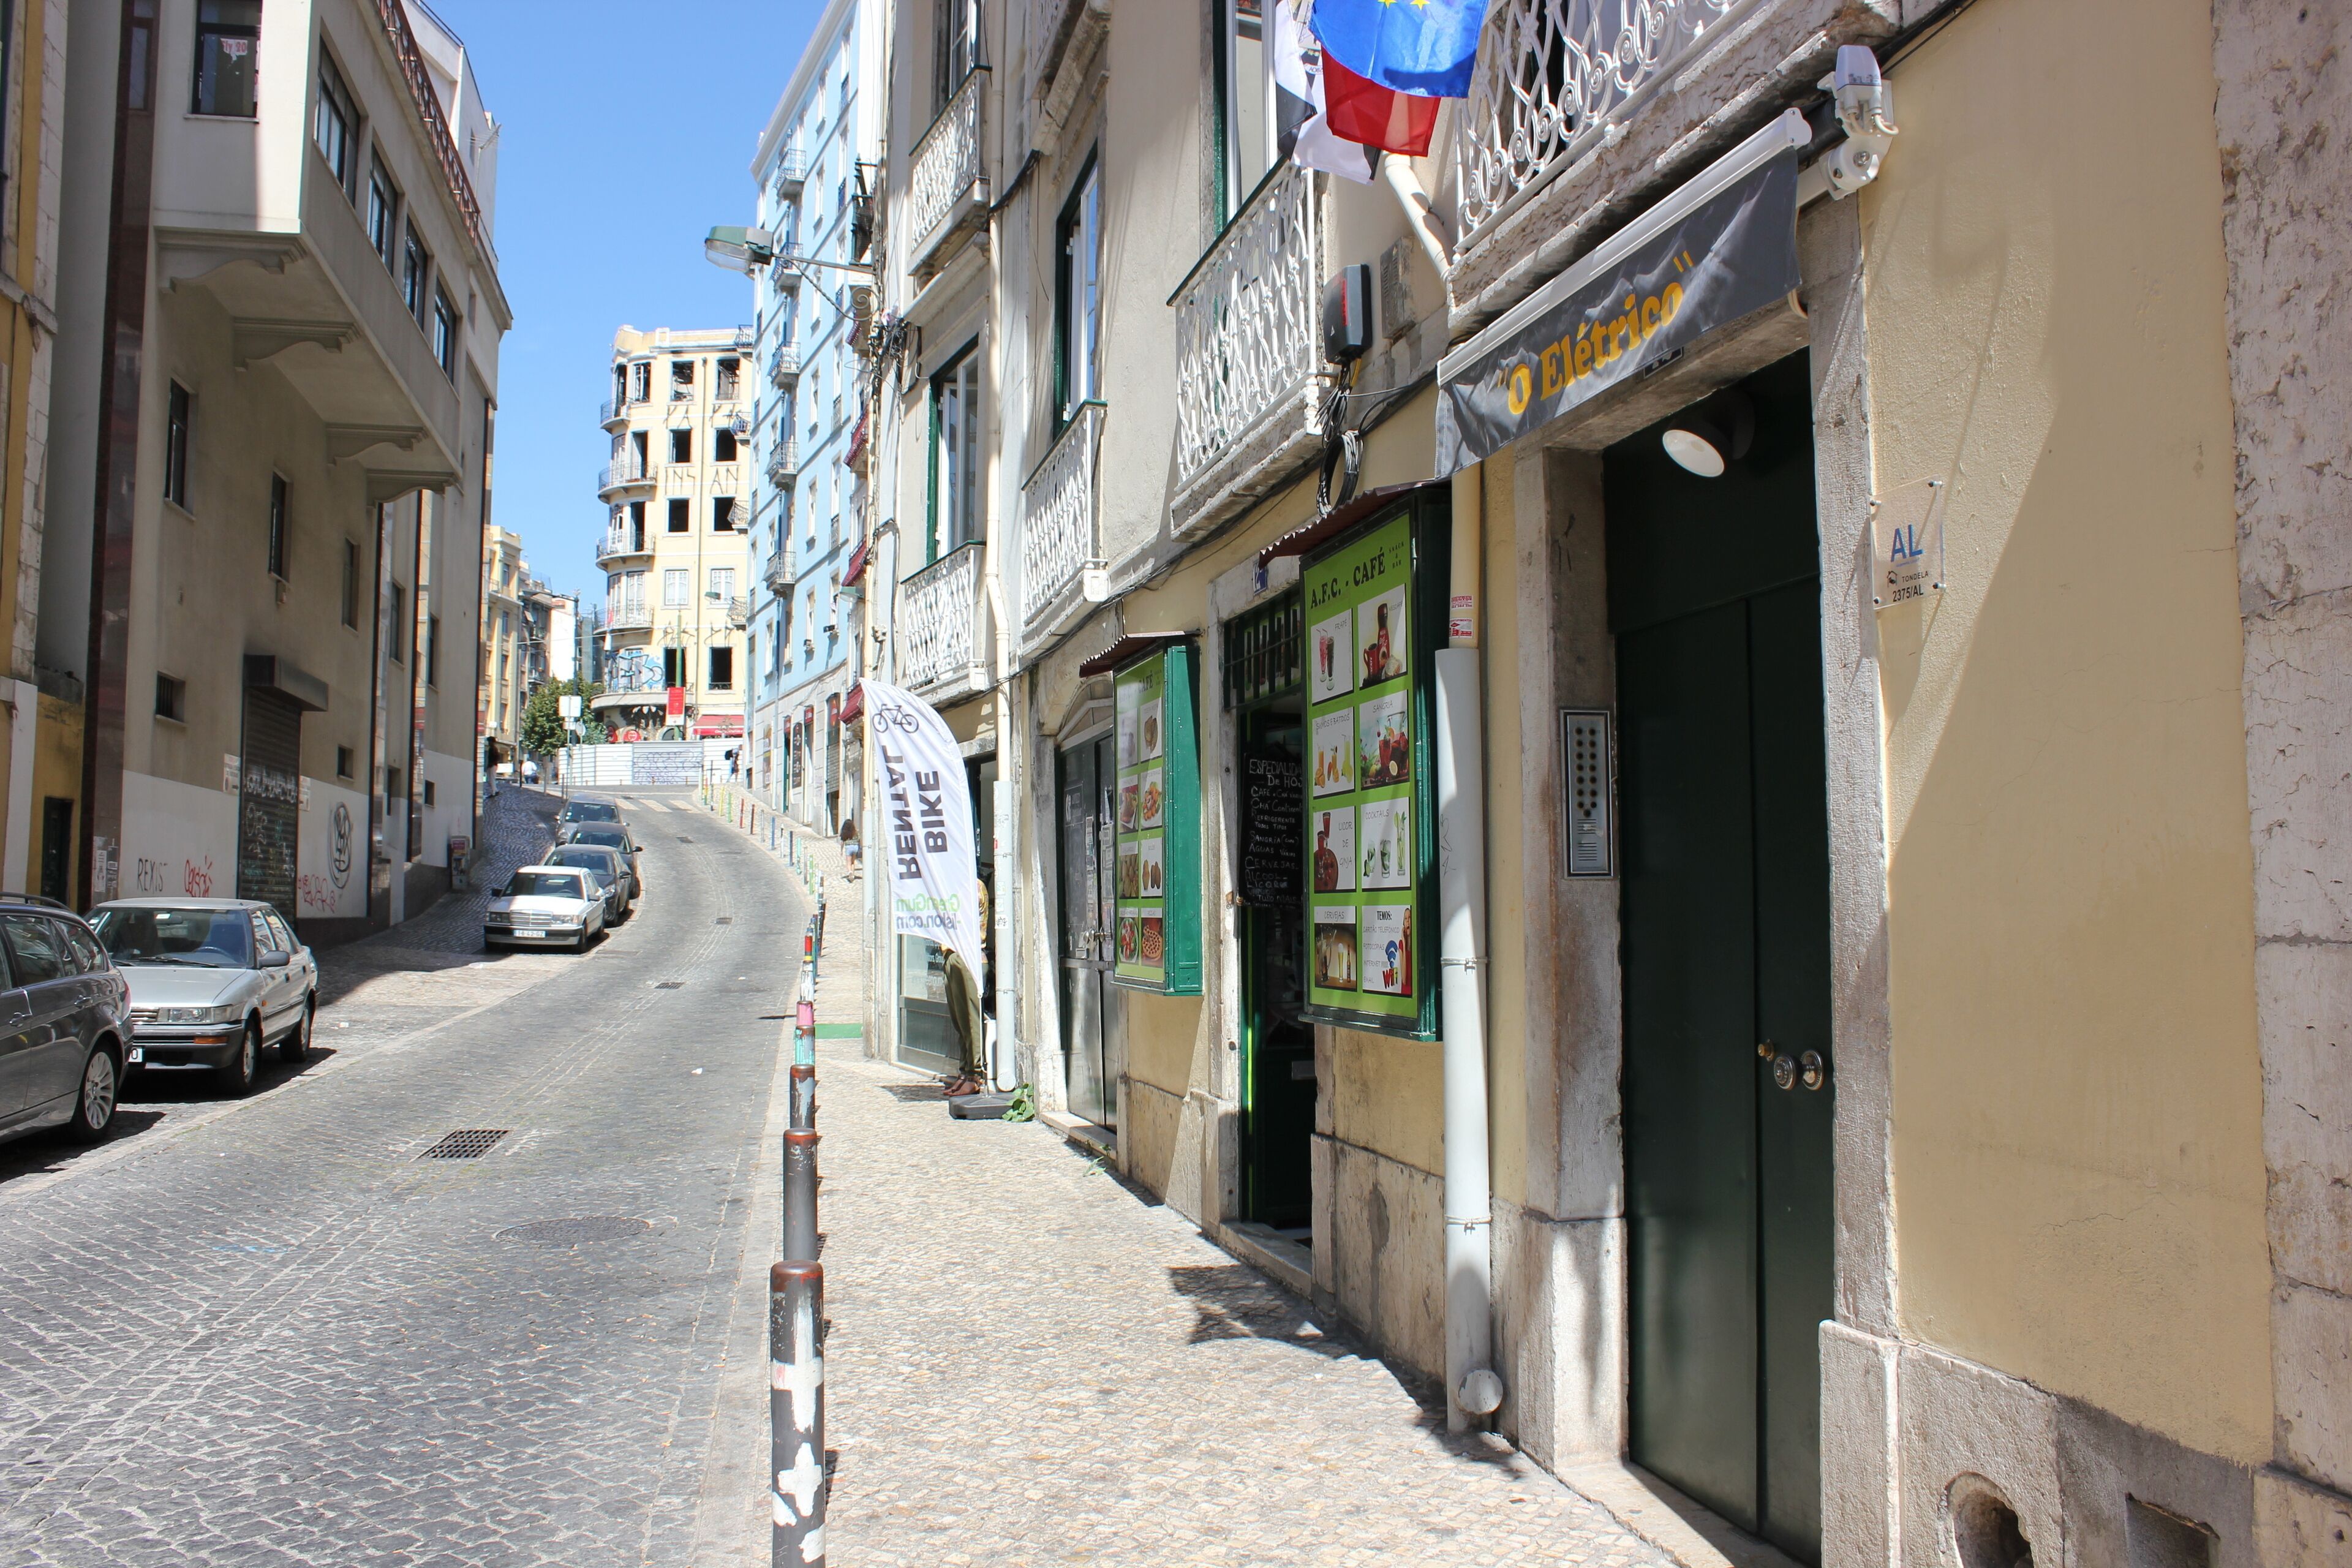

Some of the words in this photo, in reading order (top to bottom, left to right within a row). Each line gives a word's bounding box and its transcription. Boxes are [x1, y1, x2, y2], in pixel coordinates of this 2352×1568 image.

[1389, 541, 1404, 554] SNACK
[1891, 524, 1924, 562] AL
[1392, 560, 1402, 569] BAR
[1311, 578, 1341, 609] A.F.C.
[1353, 546, 1385, 587] CAFÉ
[1902, 570, 1929, 583] TONDELA
[1893, 584, 1924, 603] 2375/AL
[1372, 700, 1393, 713] SANGRIA
[1250, 759, 1303, 775] ESPECIALIDA
[1284, 776, 1303, 788] HOJ
[1365, 809, 1389, 820] COCKTAILS
[1338, 821, 1352, 831] LICOR
[1343, 839, 1349, 848] DE
[1324, 911, 1344, 922] CERVEJAS
[1377, 910, 1392, 921] TEMOS:
